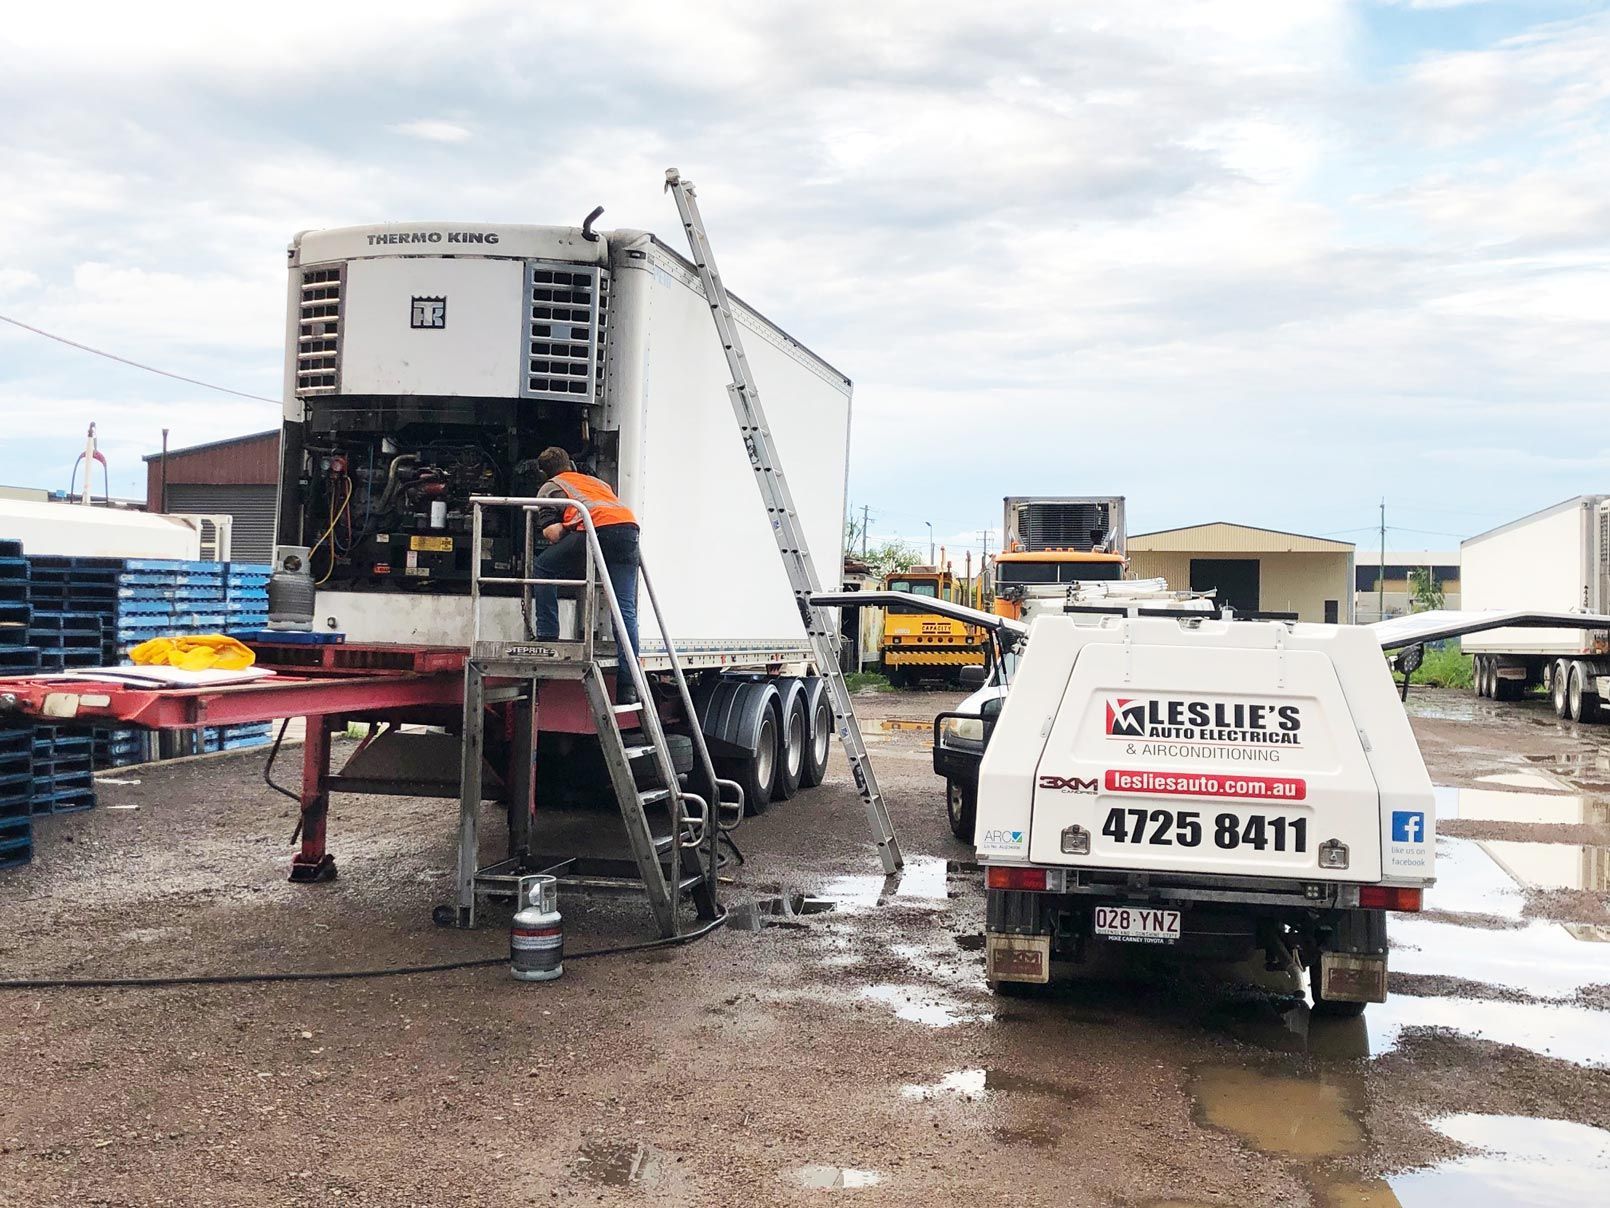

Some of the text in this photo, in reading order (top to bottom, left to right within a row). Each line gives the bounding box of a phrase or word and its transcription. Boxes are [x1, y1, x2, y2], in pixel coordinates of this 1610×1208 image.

[367, 232, 500, 245] THERMO KING
[1149, 700, 1301, 731] LESLIE'S
[1149, 727, 1301, 745] AUTO ELECTRICAL
[1126, 743, 1280, 762] & AIRCONDITIONING
[1114, 772, 1297, 796] lesliesauto.com.au
[984, 830, 1012, 843] ARC
[1102, 808, 1307, 853] 4725 8411
[1392, 858, 1425, 866] facebook
[1096, 909, 1178, 932] 028 YNZ
